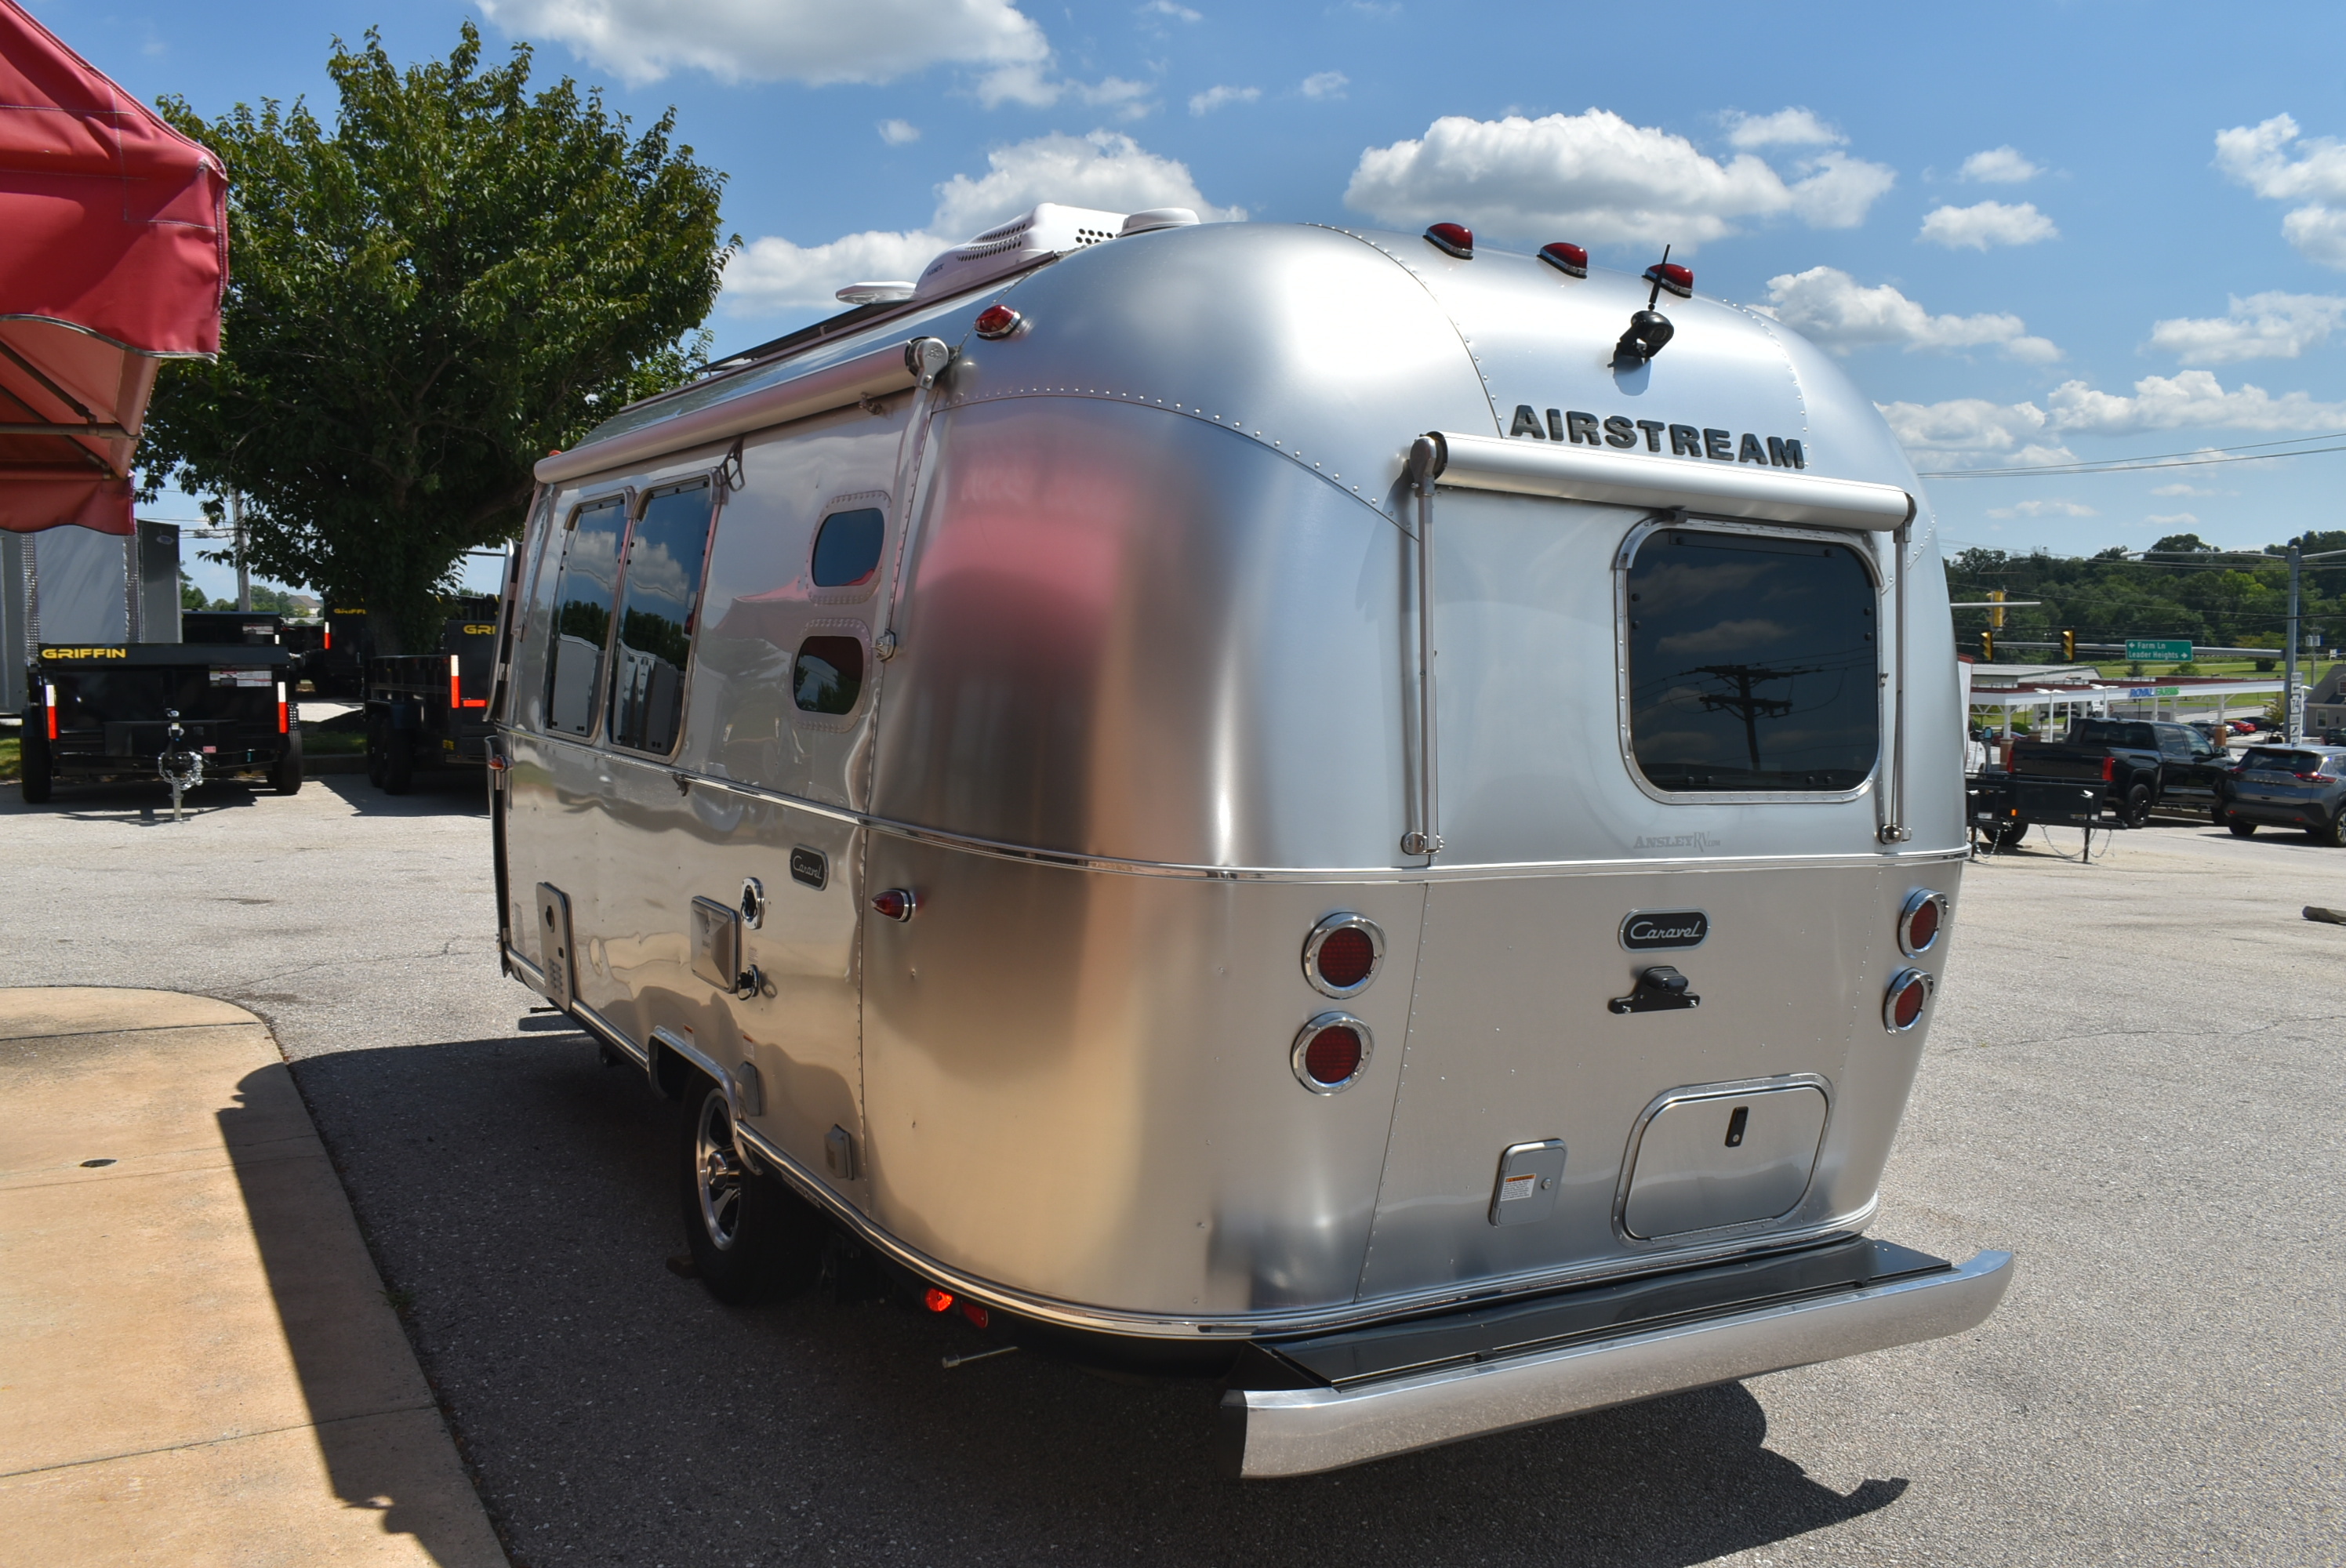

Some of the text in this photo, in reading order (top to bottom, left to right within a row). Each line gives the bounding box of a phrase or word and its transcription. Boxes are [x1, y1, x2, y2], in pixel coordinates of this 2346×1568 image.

[1510, 405, 1804, 469] AIRSTREAM
[42, 648, 126, 659] GRIFFIN
[2152, 651, 2179, 660] Heights
[2130, 688, 2155, 698] ROYAL
[793, 855, 823, 879] Caravel
[1630, 920, 1701, 940] Caravel
